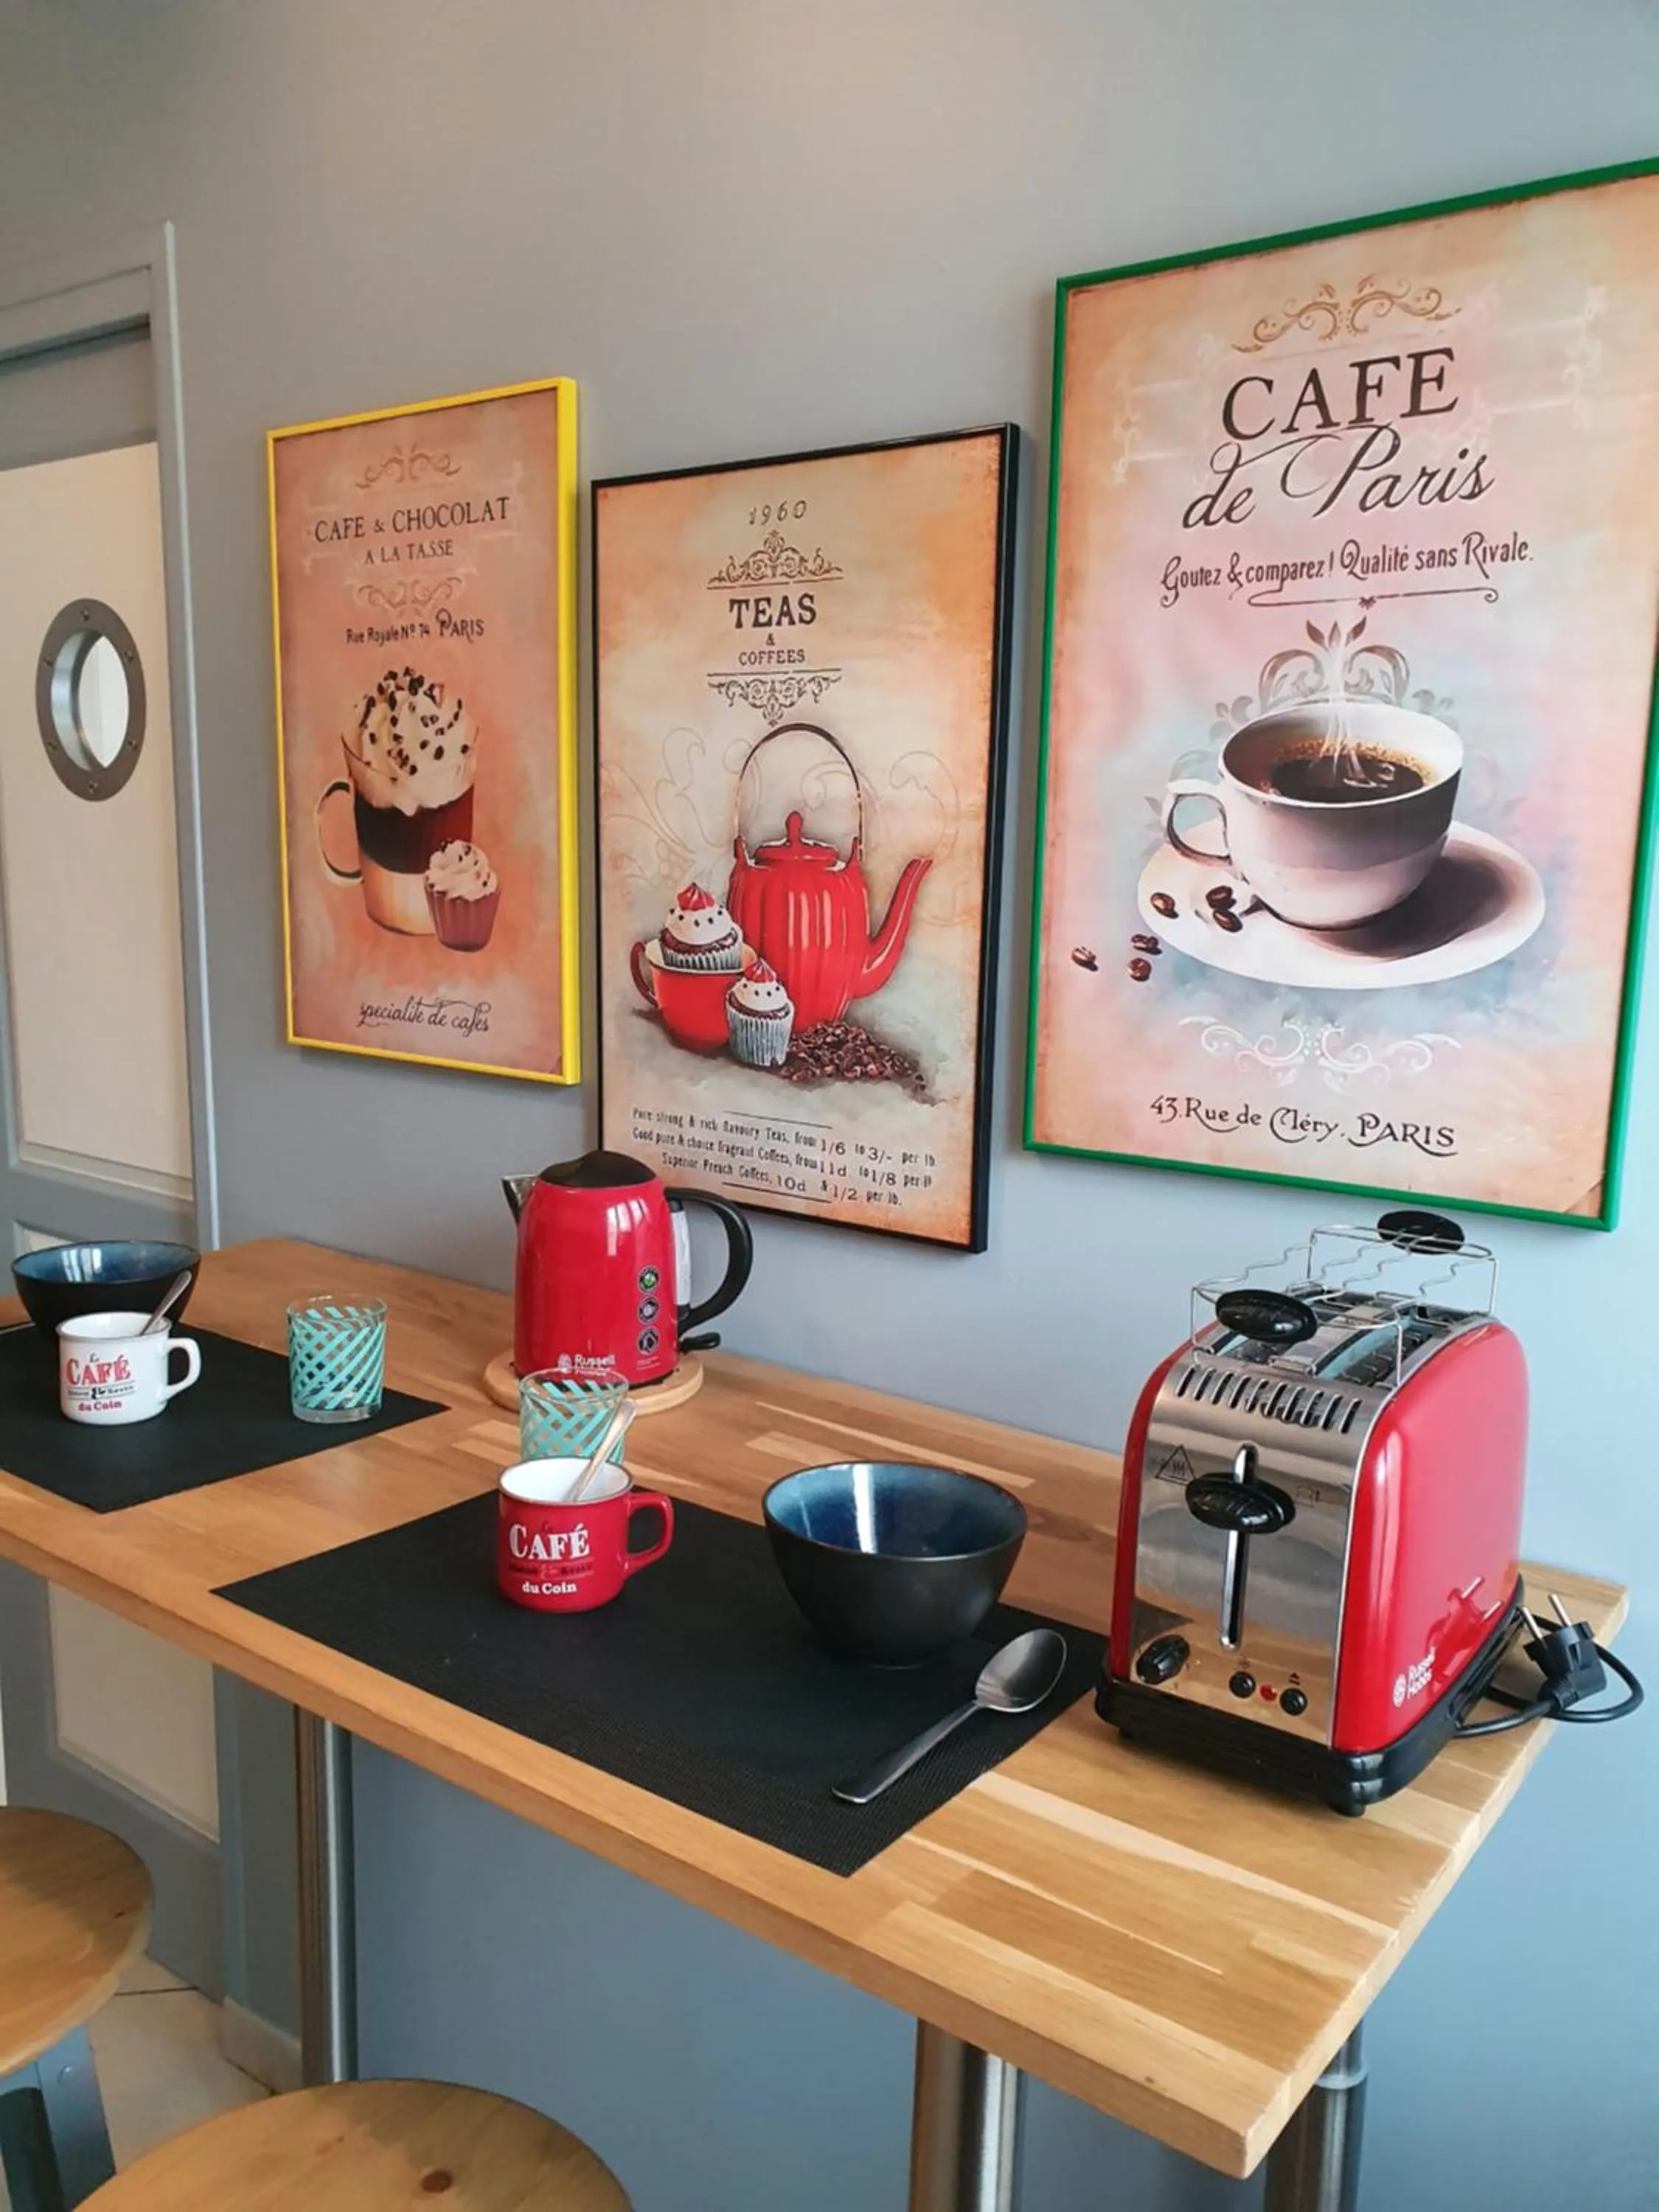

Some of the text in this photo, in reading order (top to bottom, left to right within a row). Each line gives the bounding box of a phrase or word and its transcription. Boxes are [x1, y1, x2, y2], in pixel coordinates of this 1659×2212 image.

[1221, 346, 1460, 441] CAFE
[1181, 422, 1495, 529] de Paris
[314, 496, 510, 543] CAFE & CHOCOLAT
[748, 499, 807, 526] 1960
[364, 538, 454, 565] A LA TASSE
[1160, 554, 1222, 608] Goutez
[1227, 552, 1245, 596] &
[1339, 538, 1410, 582] Qualité
[1414, 544, 1458, 571] sans
[1461, 530, 1534, 580] Rivale.
[728, 592, 818, 630] TEAS
[765, 632, 776, 647] &
[738, 648, 806, 667] COFFEES
[1237, 1104, 1262, 1126] de
[1347, 1111, 1459, 1158] PARIS
[821, 1138, 846, 1156] 1/6
[855, 1143, 866, 1156] to
[867, 1146, 893, 1164] 3/-
[776, 1174, 807, 1192] 10d
[833, 1184, 858, 1202] 1/2
[858, 1165, 869, 1178] to
[872, 1169, 897, 1186] 1/8
[66, 1354, 131, 1385] CAFÉ
[509, 1523, 590, 1560] CAFÉ
[521, 1580, 577, 1595] du Coin
